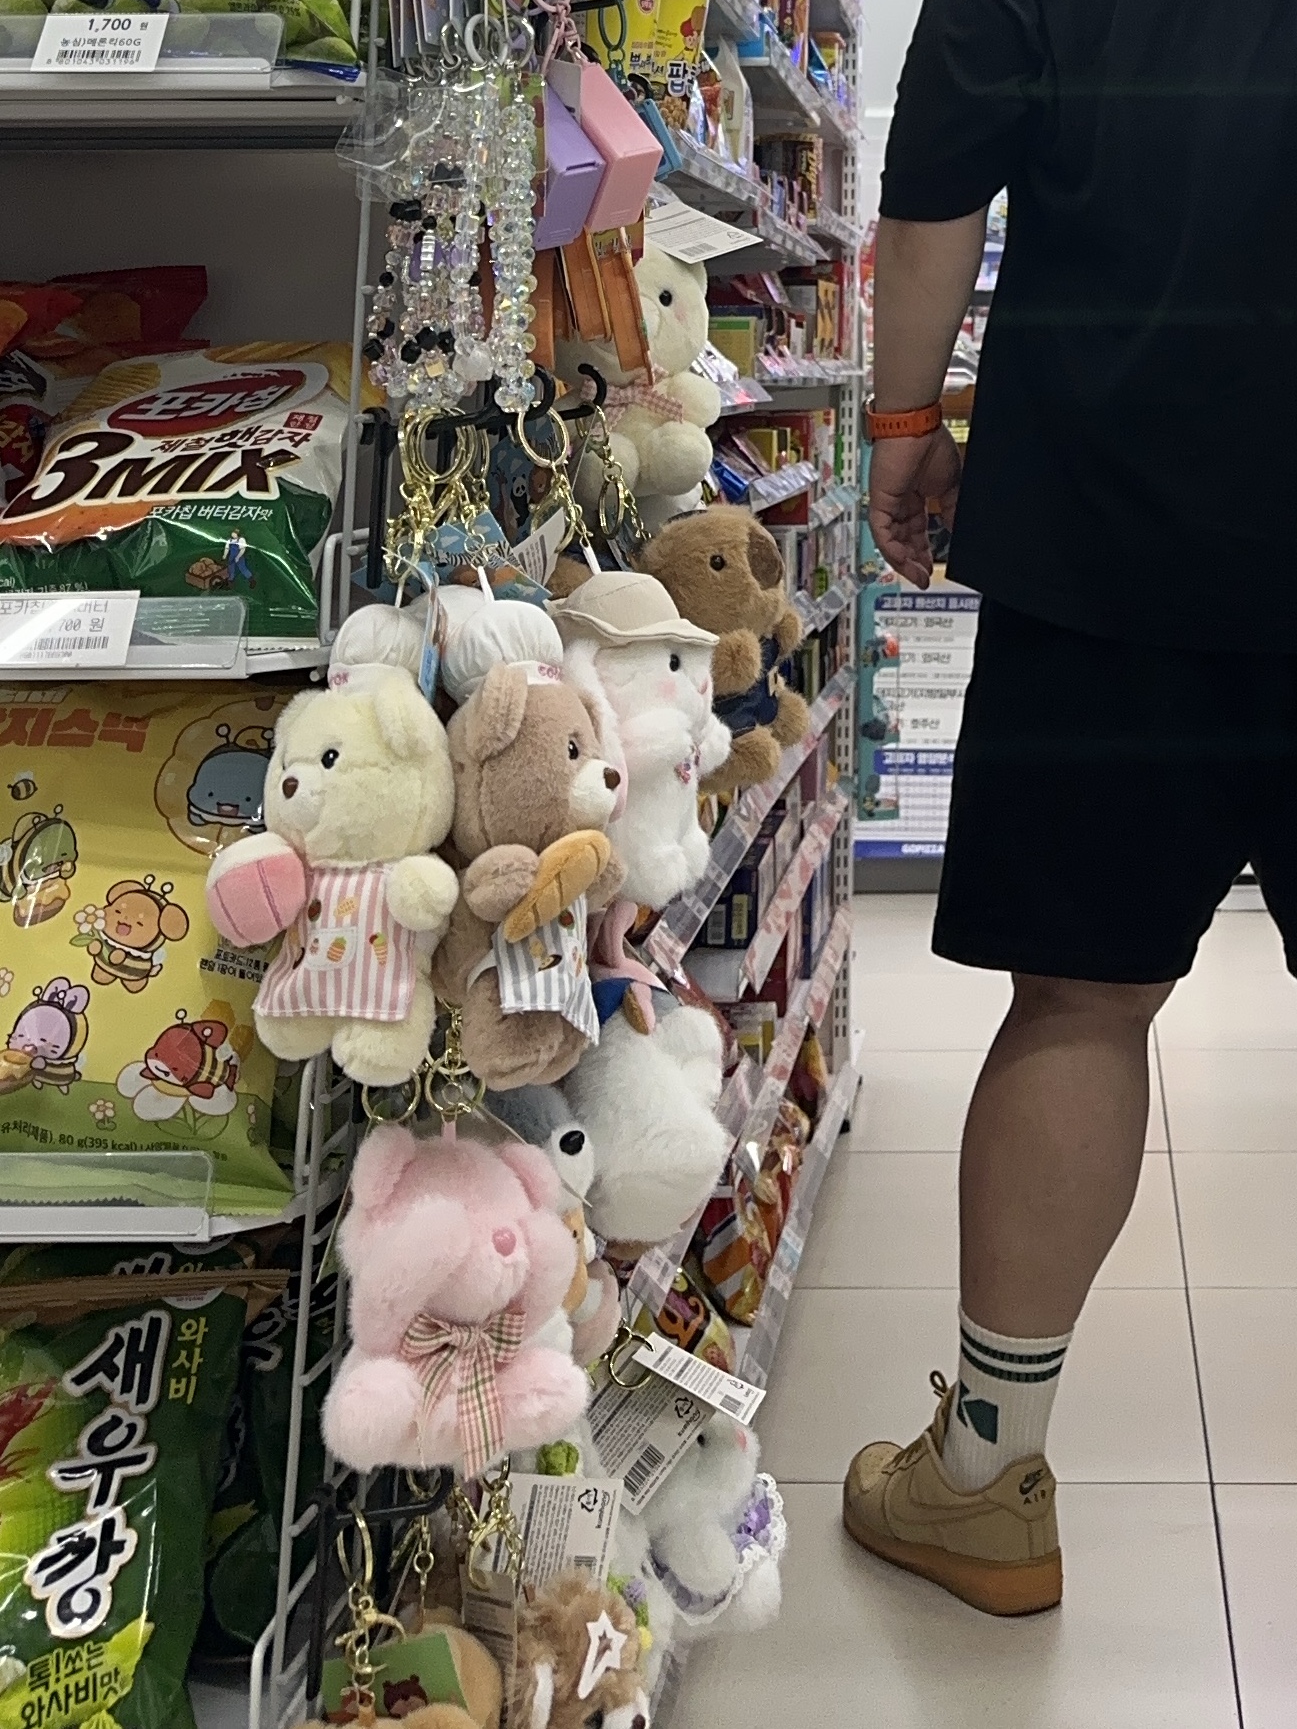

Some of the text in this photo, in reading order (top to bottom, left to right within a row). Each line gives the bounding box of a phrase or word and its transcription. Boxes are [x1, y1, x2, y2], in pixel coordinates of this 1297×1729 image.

[87, 18, 132, 32] 1,700
[118, 383, 293, 422] 포카칩
[2, 430, 302, 520] 3MIX
[150, 504, 274, 521] 포카칩 버터감자맛
[89, 617, 105, 633] 원
[58, 1133, 74, 1146] 80
[168, 1317, 210, 1405] 와사비
[26, 1309, 172, 1637] 새우깡
[1023, 1489, 1047, 1506] AIR
[28, 1640, 108, 1691] 톡!쏘는
[20, 1668, 123, 1729] 와사비맛
